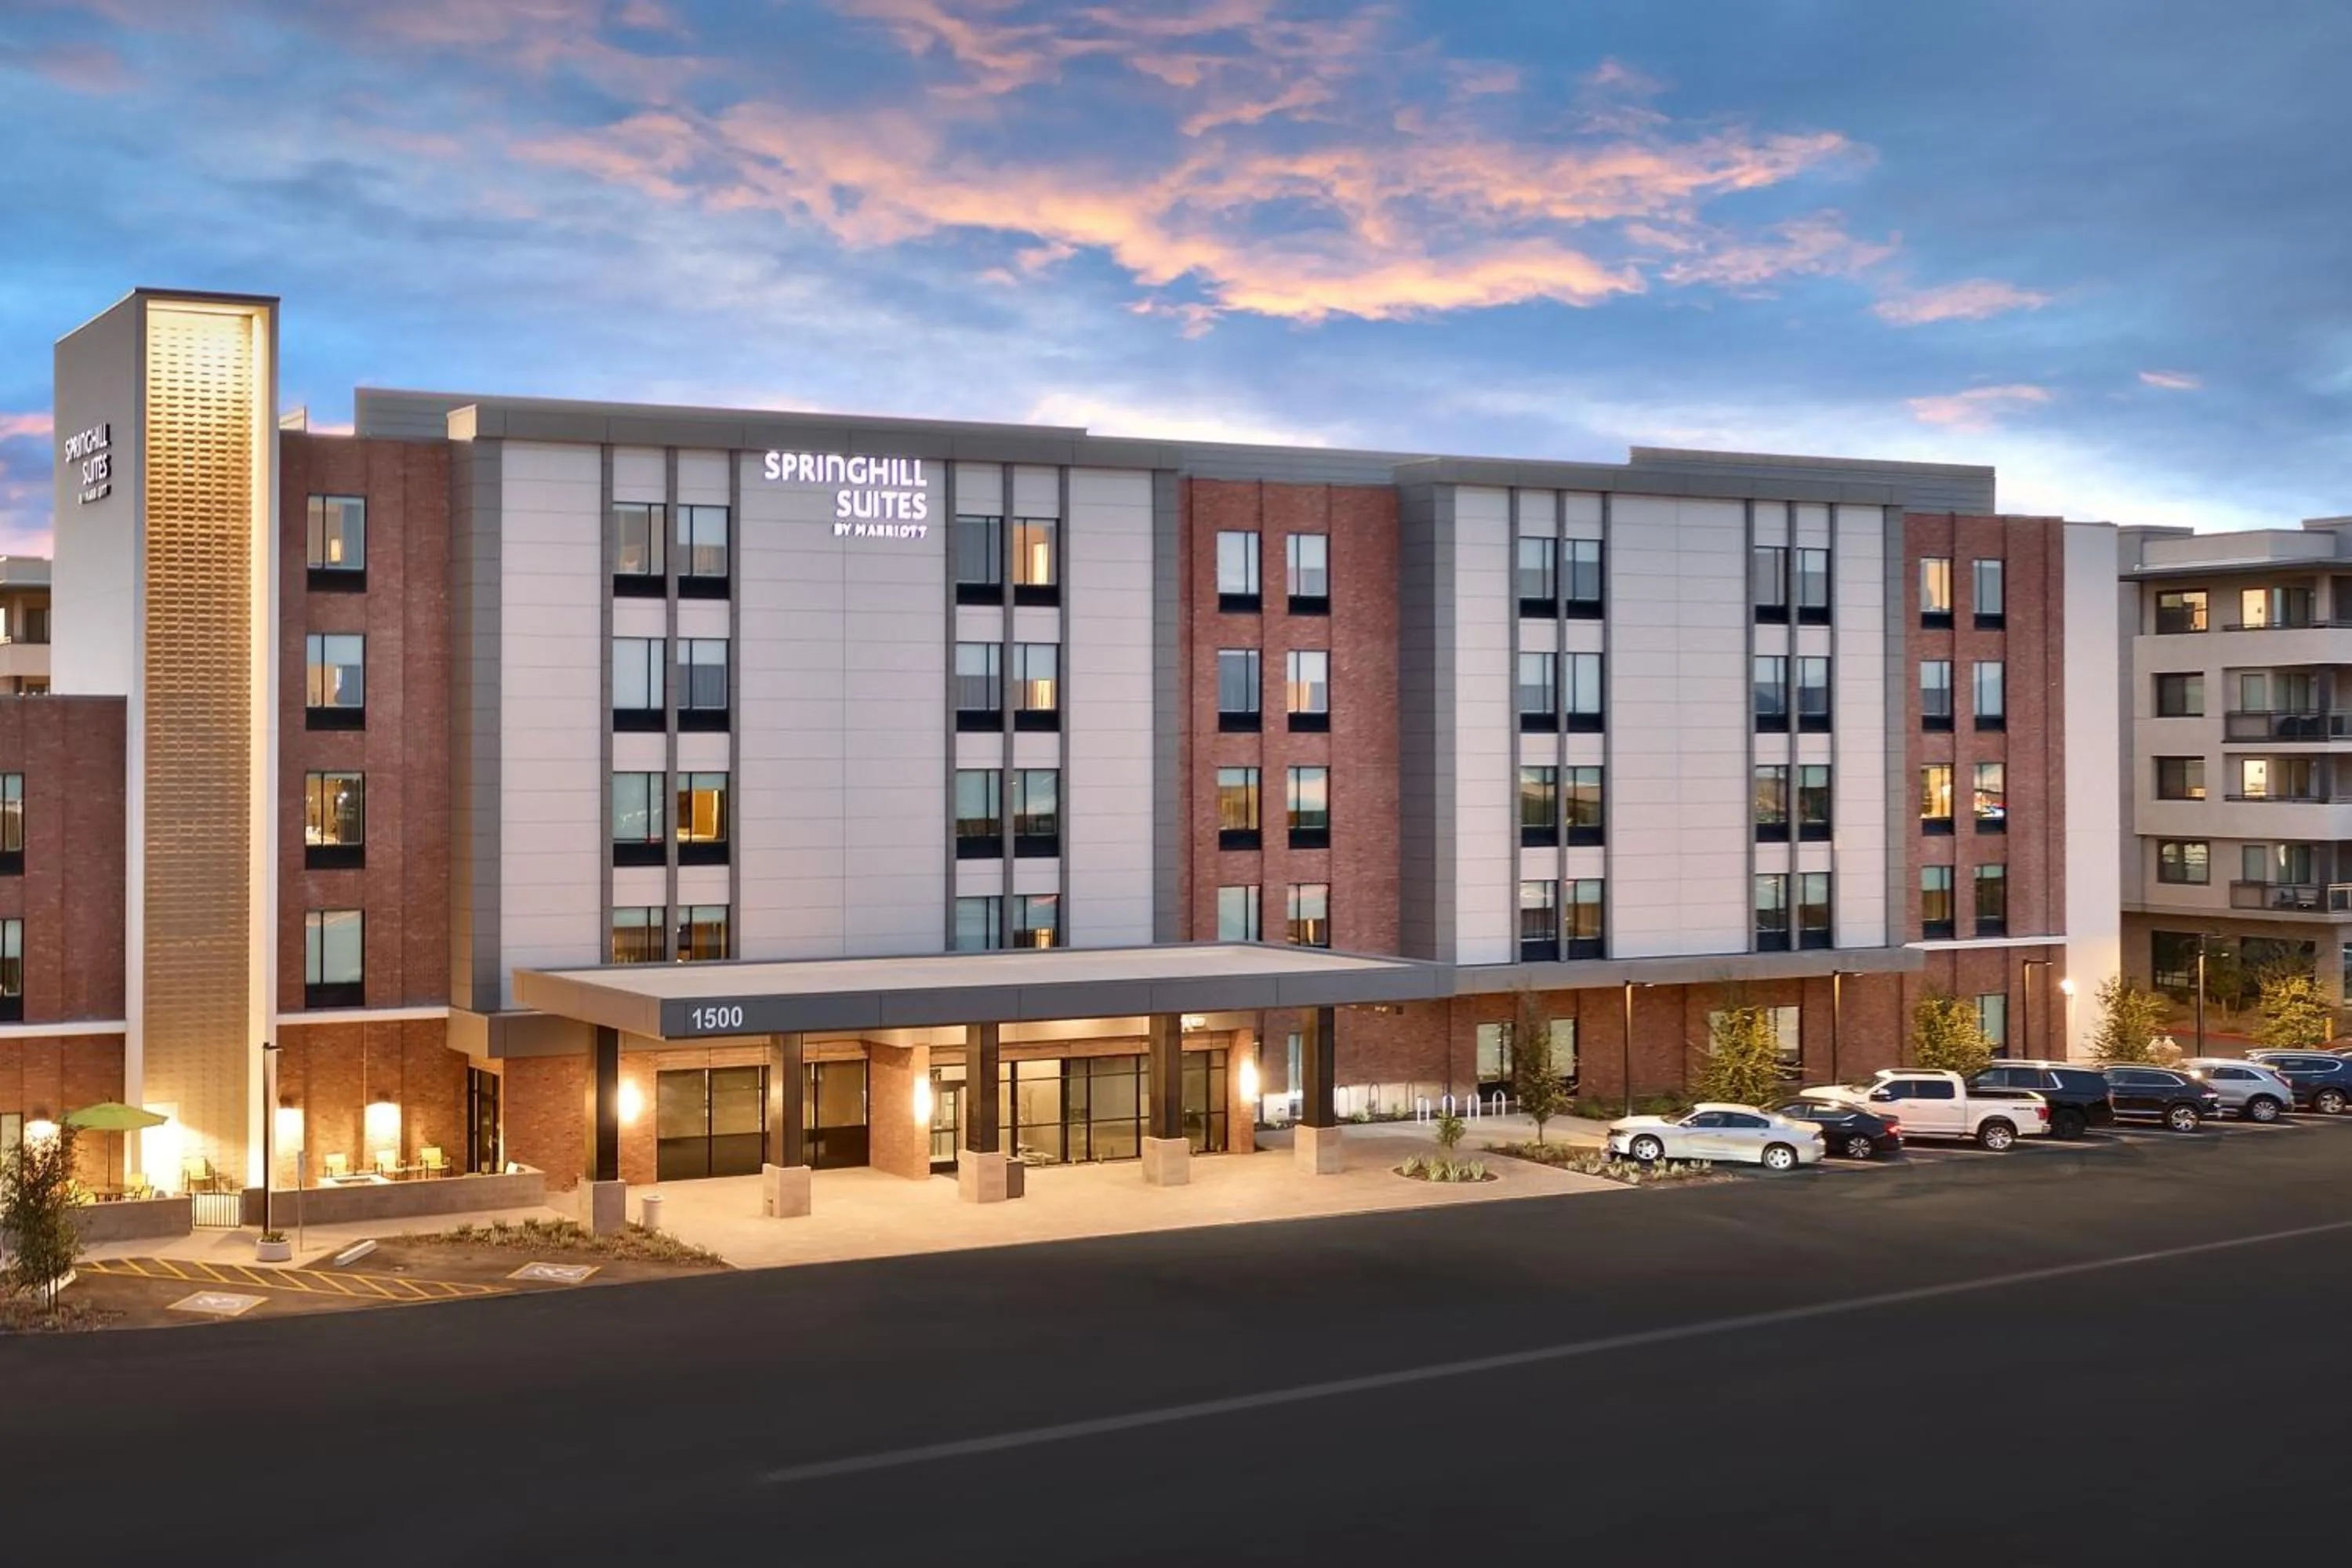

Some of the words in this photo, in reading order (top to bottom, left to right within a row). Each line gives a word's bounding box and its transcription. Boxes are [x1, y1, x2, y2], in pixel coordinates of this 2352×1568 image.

[764, 450, 927, 487] SPRINGHILL
[836, 489, 927, 520] SUITES
[834, 523, 852, 536] BY
[855, 524, 927, 539] MARRIOTT
[691, 1006, 743, 1029] 1500
